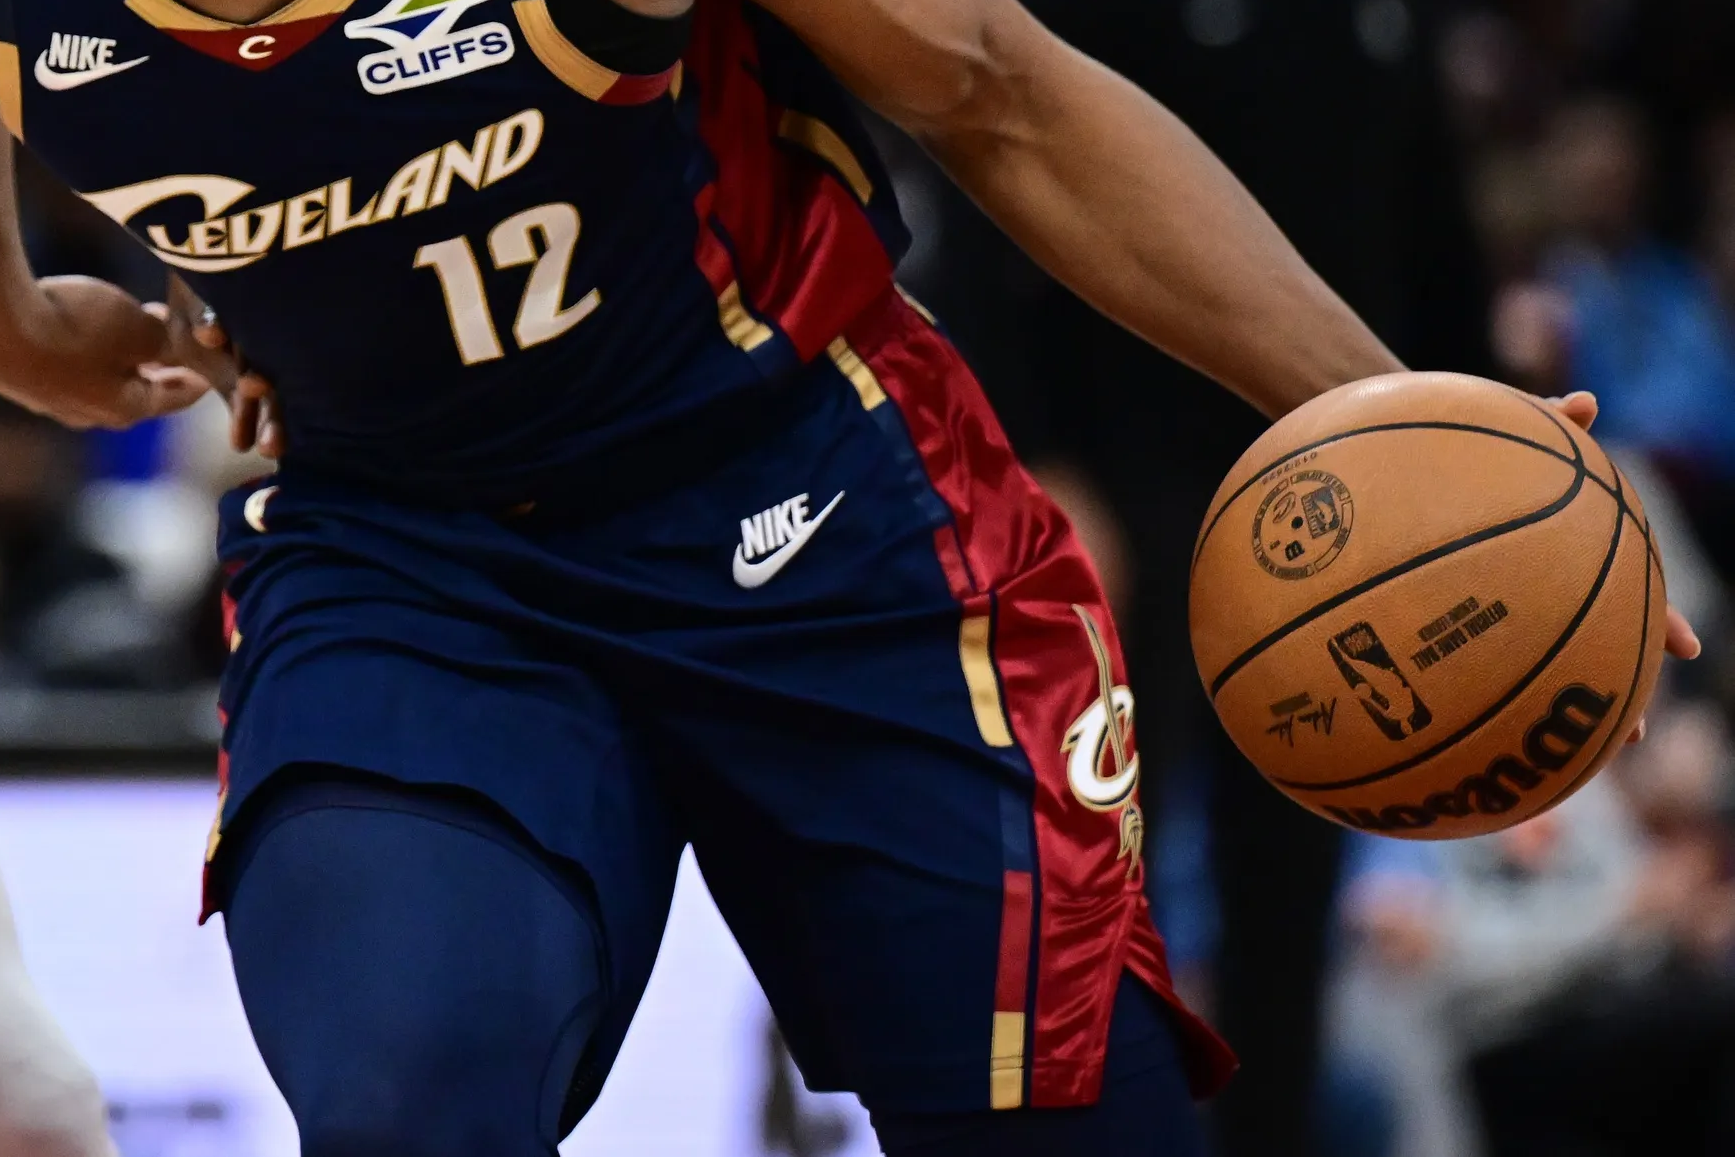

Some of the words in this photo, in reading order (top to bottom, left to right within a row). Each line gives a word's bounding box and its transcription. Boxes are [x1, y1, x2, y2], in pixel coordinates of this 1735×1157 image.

[47, 32, 117, 71] NIKE
[238, 34, 276, 60] C
[365, 31, 509, 85] CLIFFS
[79, 108, 545, 273] CLEVELAND
[412, 201, 601, 366] 12
[740, 492, 811, 562] NIKE
